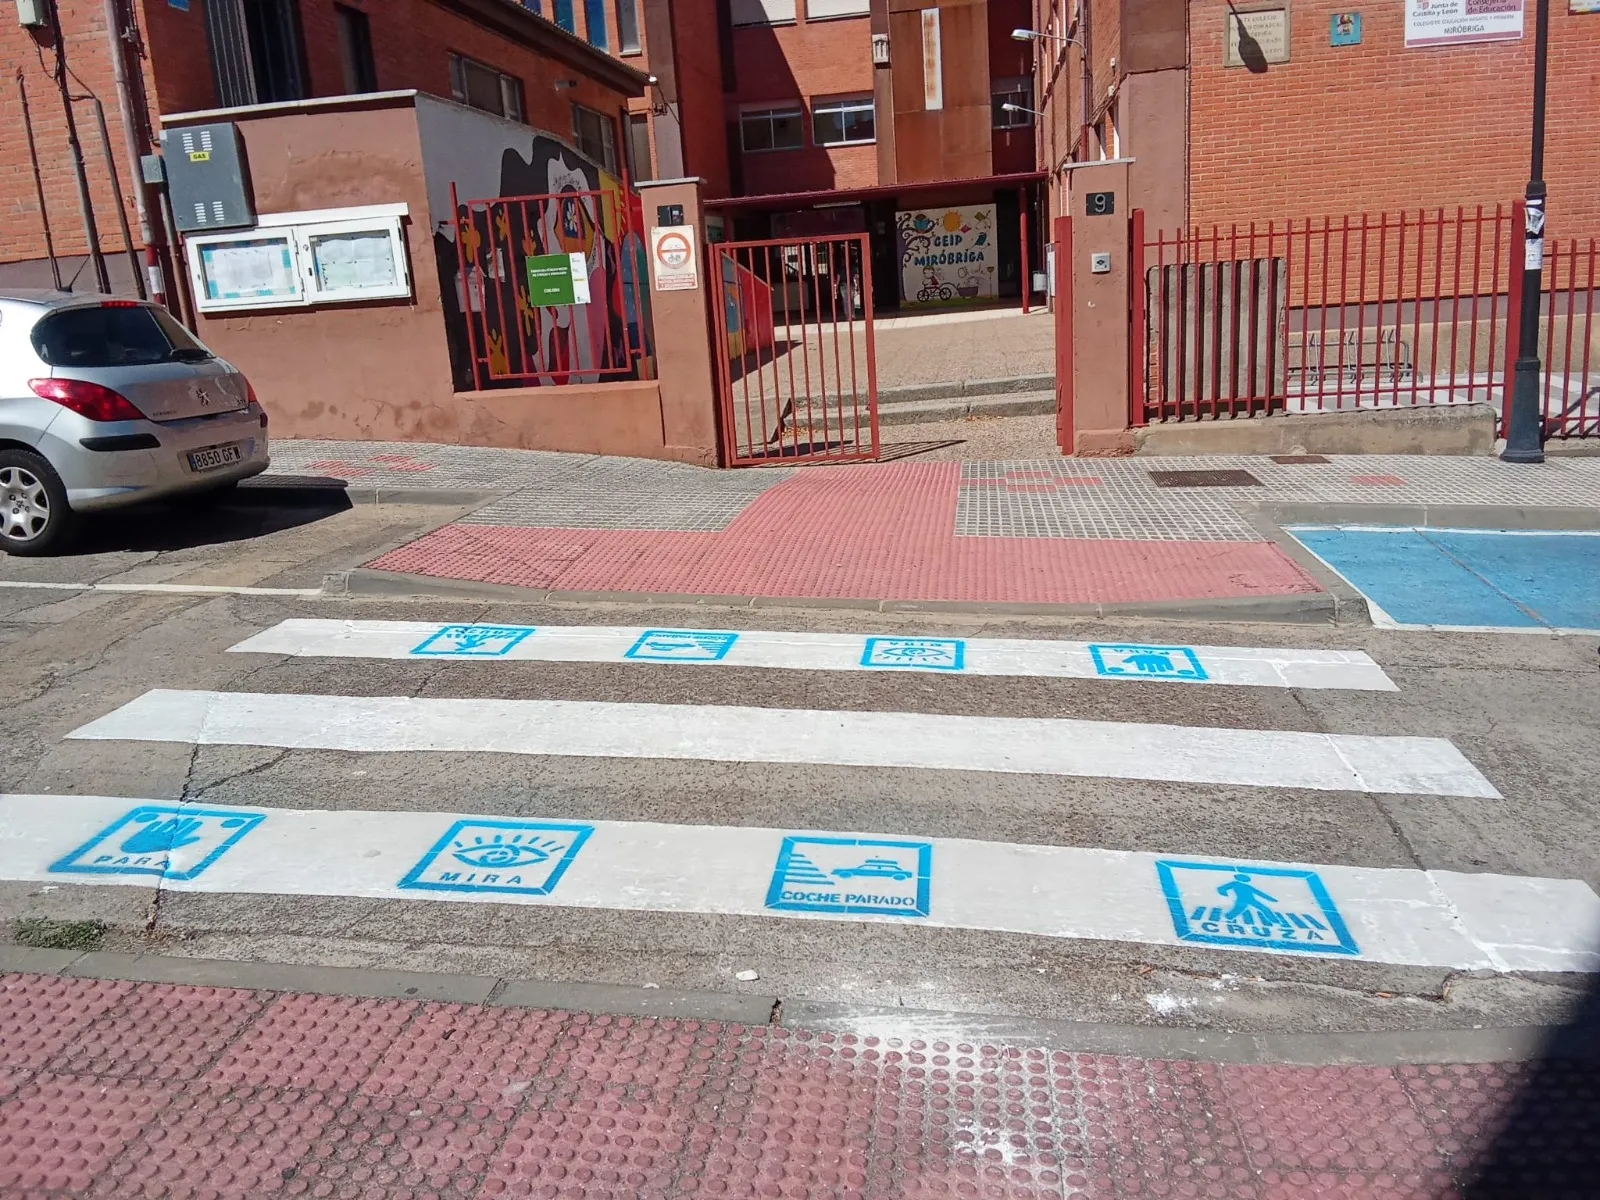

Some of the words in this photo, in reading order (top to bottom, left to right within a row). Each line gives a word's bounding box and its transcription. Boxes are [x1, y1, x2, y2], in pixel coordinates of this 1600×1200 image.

[1479, 5, 1516, 13] Educación
[1444, 24, 1485, 34] MIRÓBRIGA
[1094, 194, 1106, 213] 9
[914, 249, 985, 266] MIRÓBRIGA
[195, 450, 221, 468] 8850
[93, 856, 171, 867] PARA
[439, 872, 522, 885] MIRA
[781, 890, 841, 903] COCHE
[844, 894, 915, 906] PARADO
[1202, 922, 1324, 941] CRUZA
